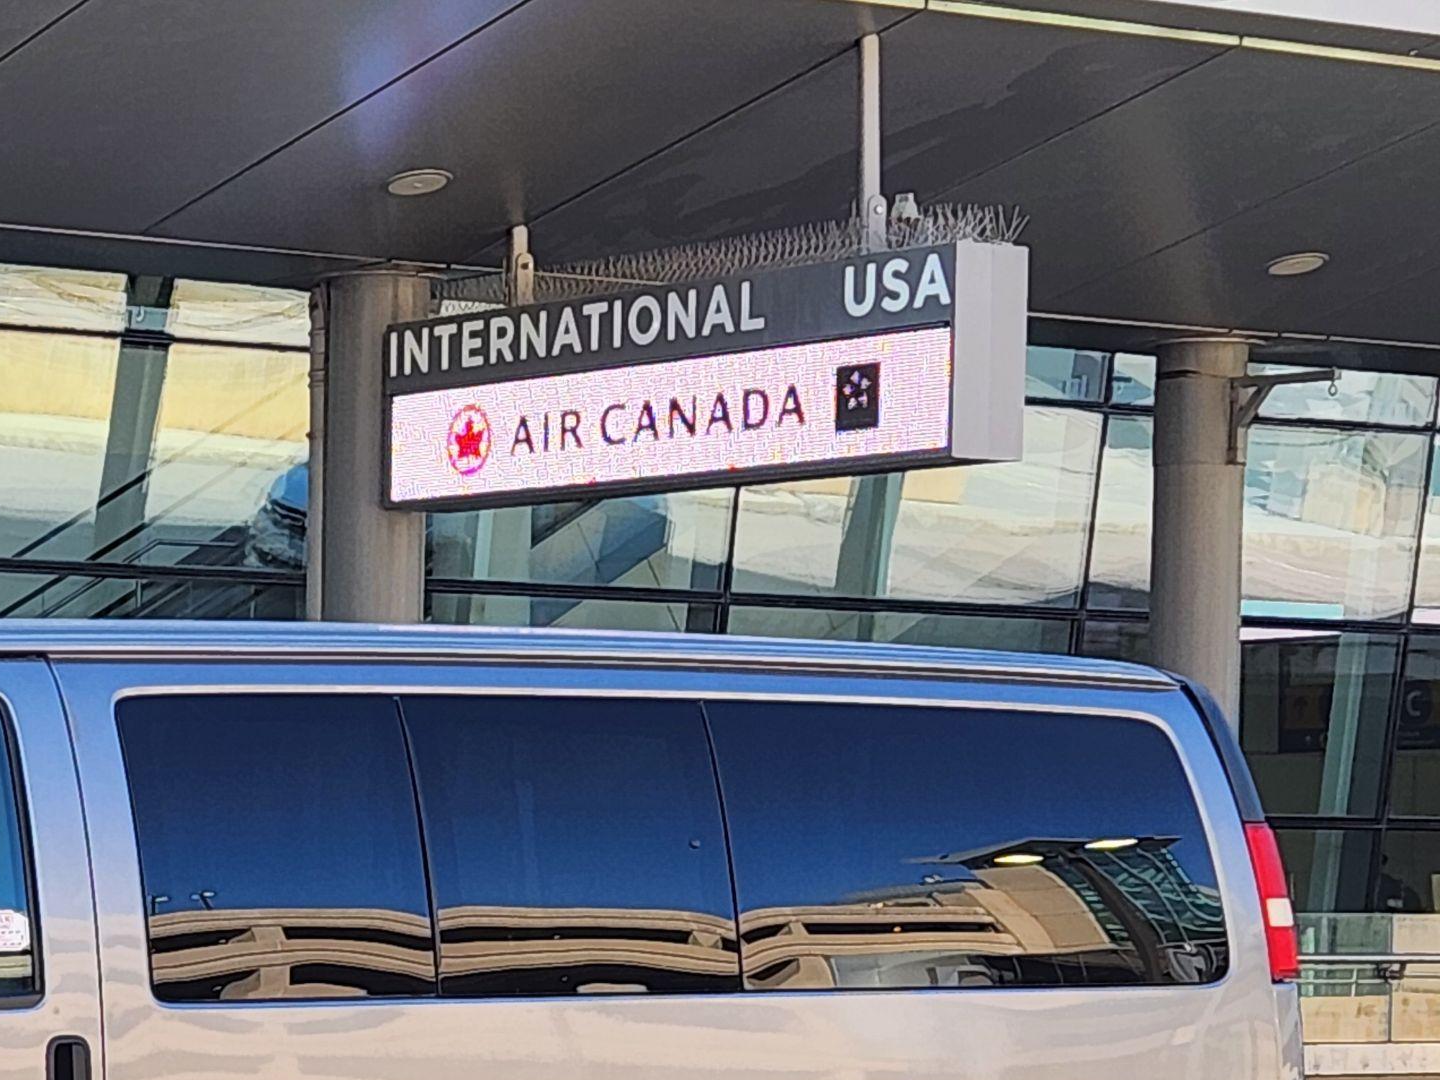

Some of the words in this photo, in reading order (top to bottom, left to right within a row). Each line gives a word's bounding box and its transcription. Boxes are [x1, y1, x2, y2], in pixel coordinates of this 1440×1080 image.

[389, 281, 765, 377] INTERNATIONAL
[844, 253, 951, 317] USA
[510, 409, 583, 456] AIR
[600, 384, 805, 446] CANADA
